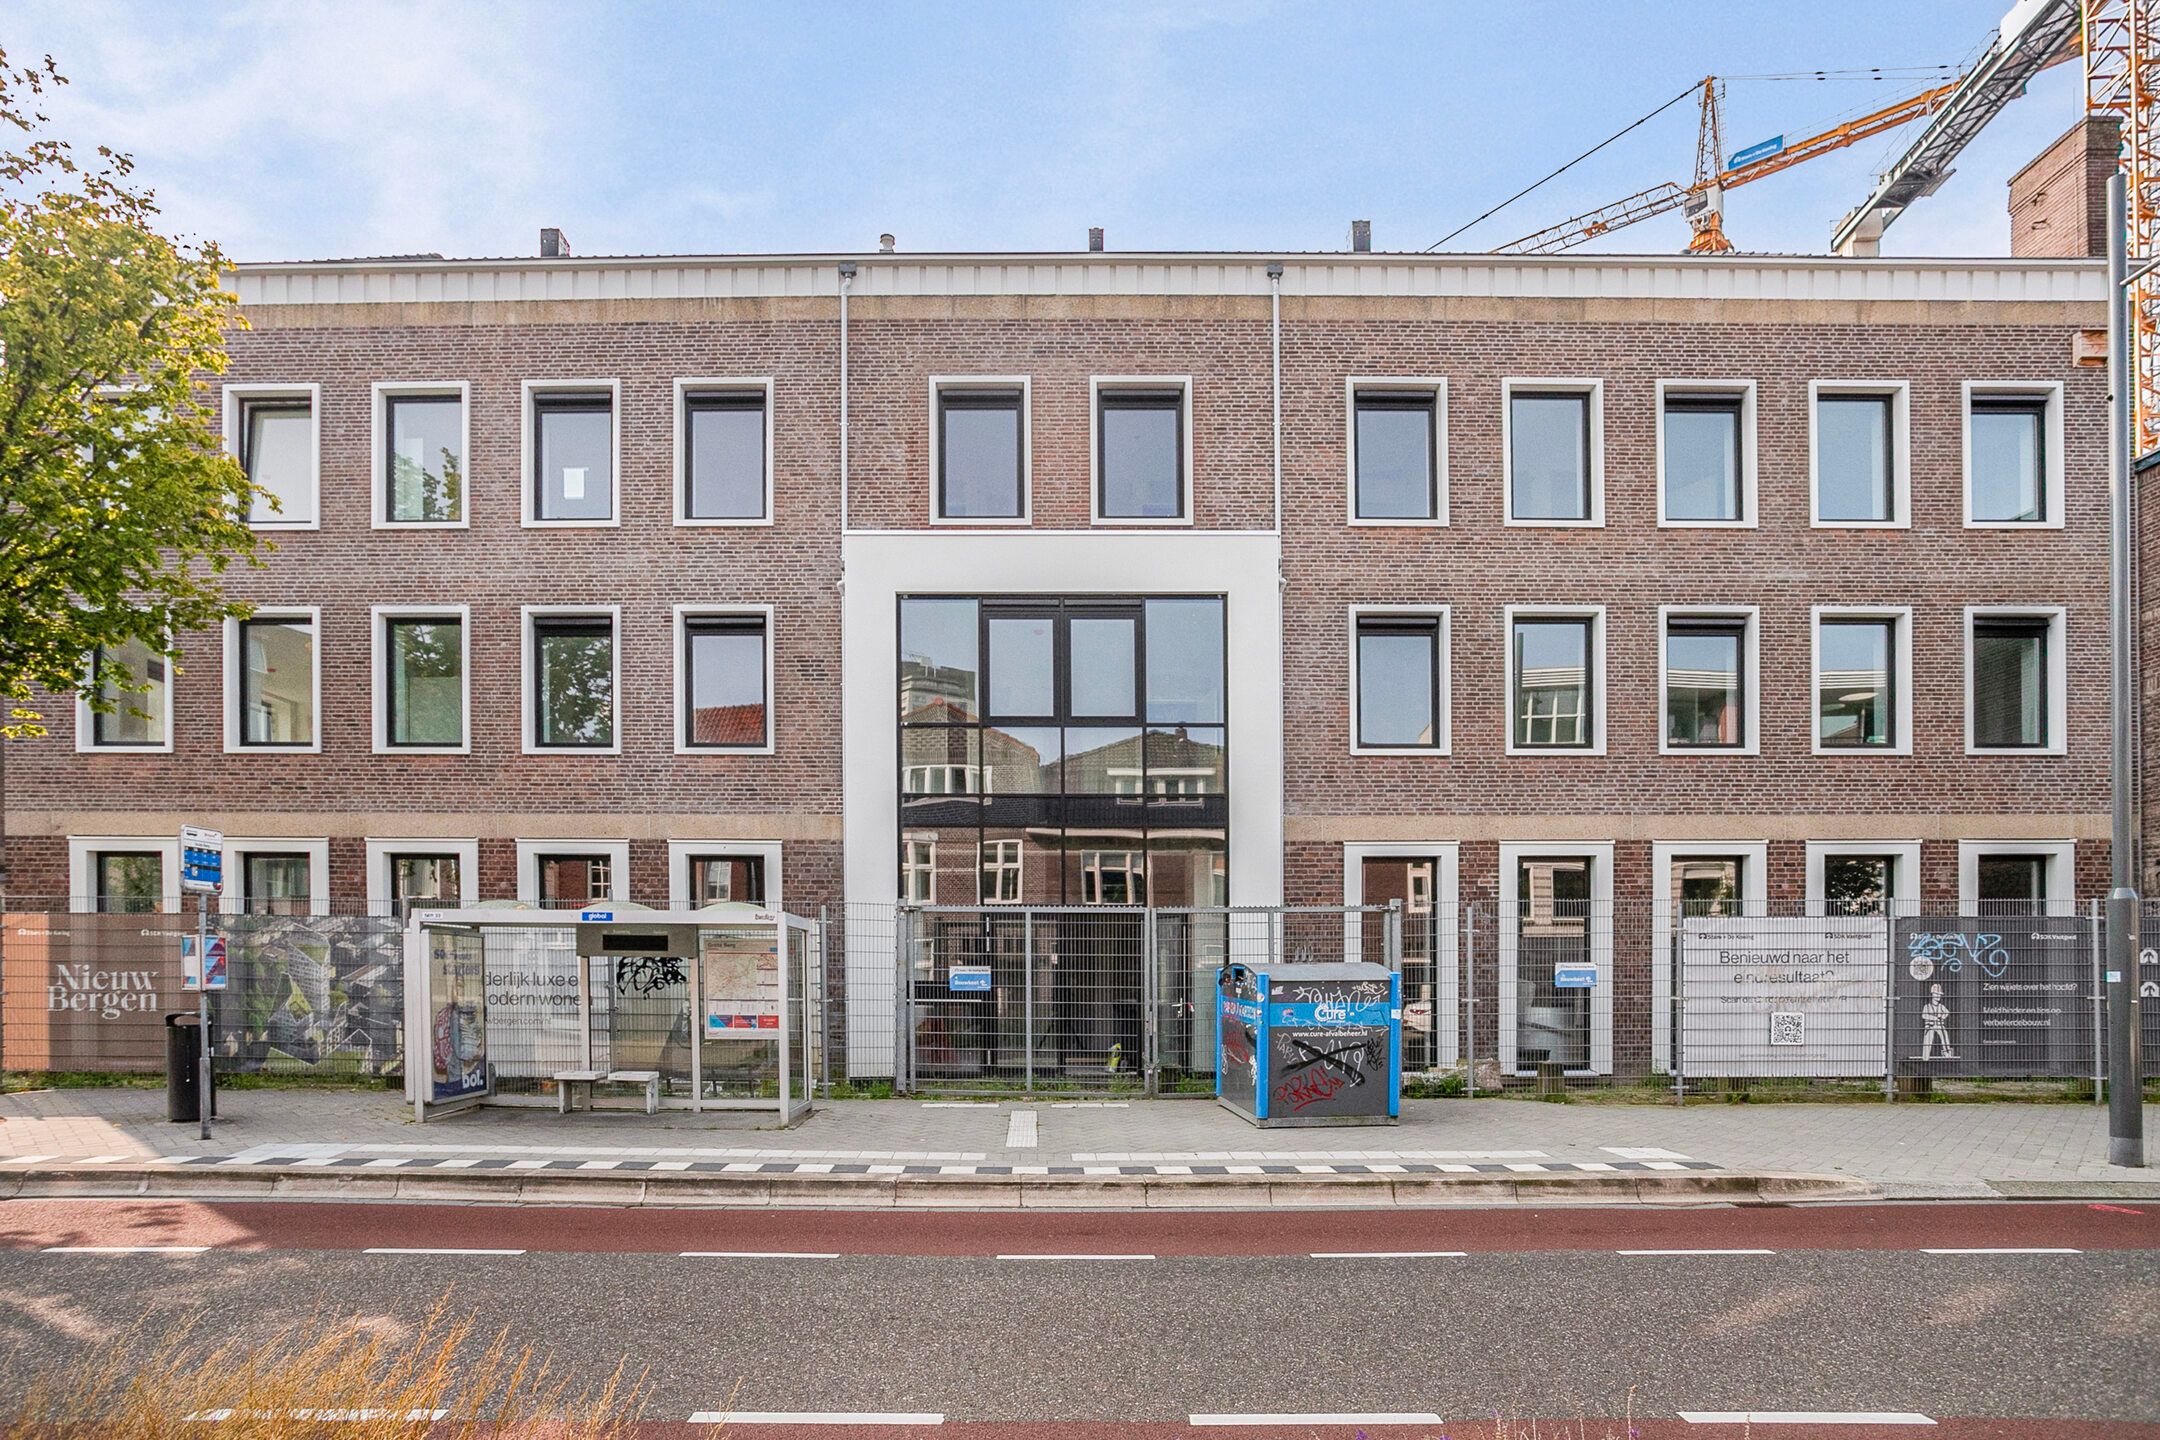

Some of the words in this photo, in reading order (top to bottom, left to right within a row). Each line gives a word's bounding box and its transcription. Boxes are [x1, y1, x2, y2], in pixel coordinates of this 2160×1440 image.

[588, 912, 608, 921] global
[1720, 951, 1790, 964] Benieuwd
[1793, 953, 1824, 964] naar
[1827, 951, 1850, 964] het
[56, 964, 159, 991] Nieuw
[533, 972, 564, 986] luxe
[1734, 970, 1834, 984] enesultaat?
[47, 986, 157, 1020] Bergen
[1315, 1004, 1346, 1022] Cure
[1292, 1030, 1368, 1038] www.cure-afvalbeheer.nl
